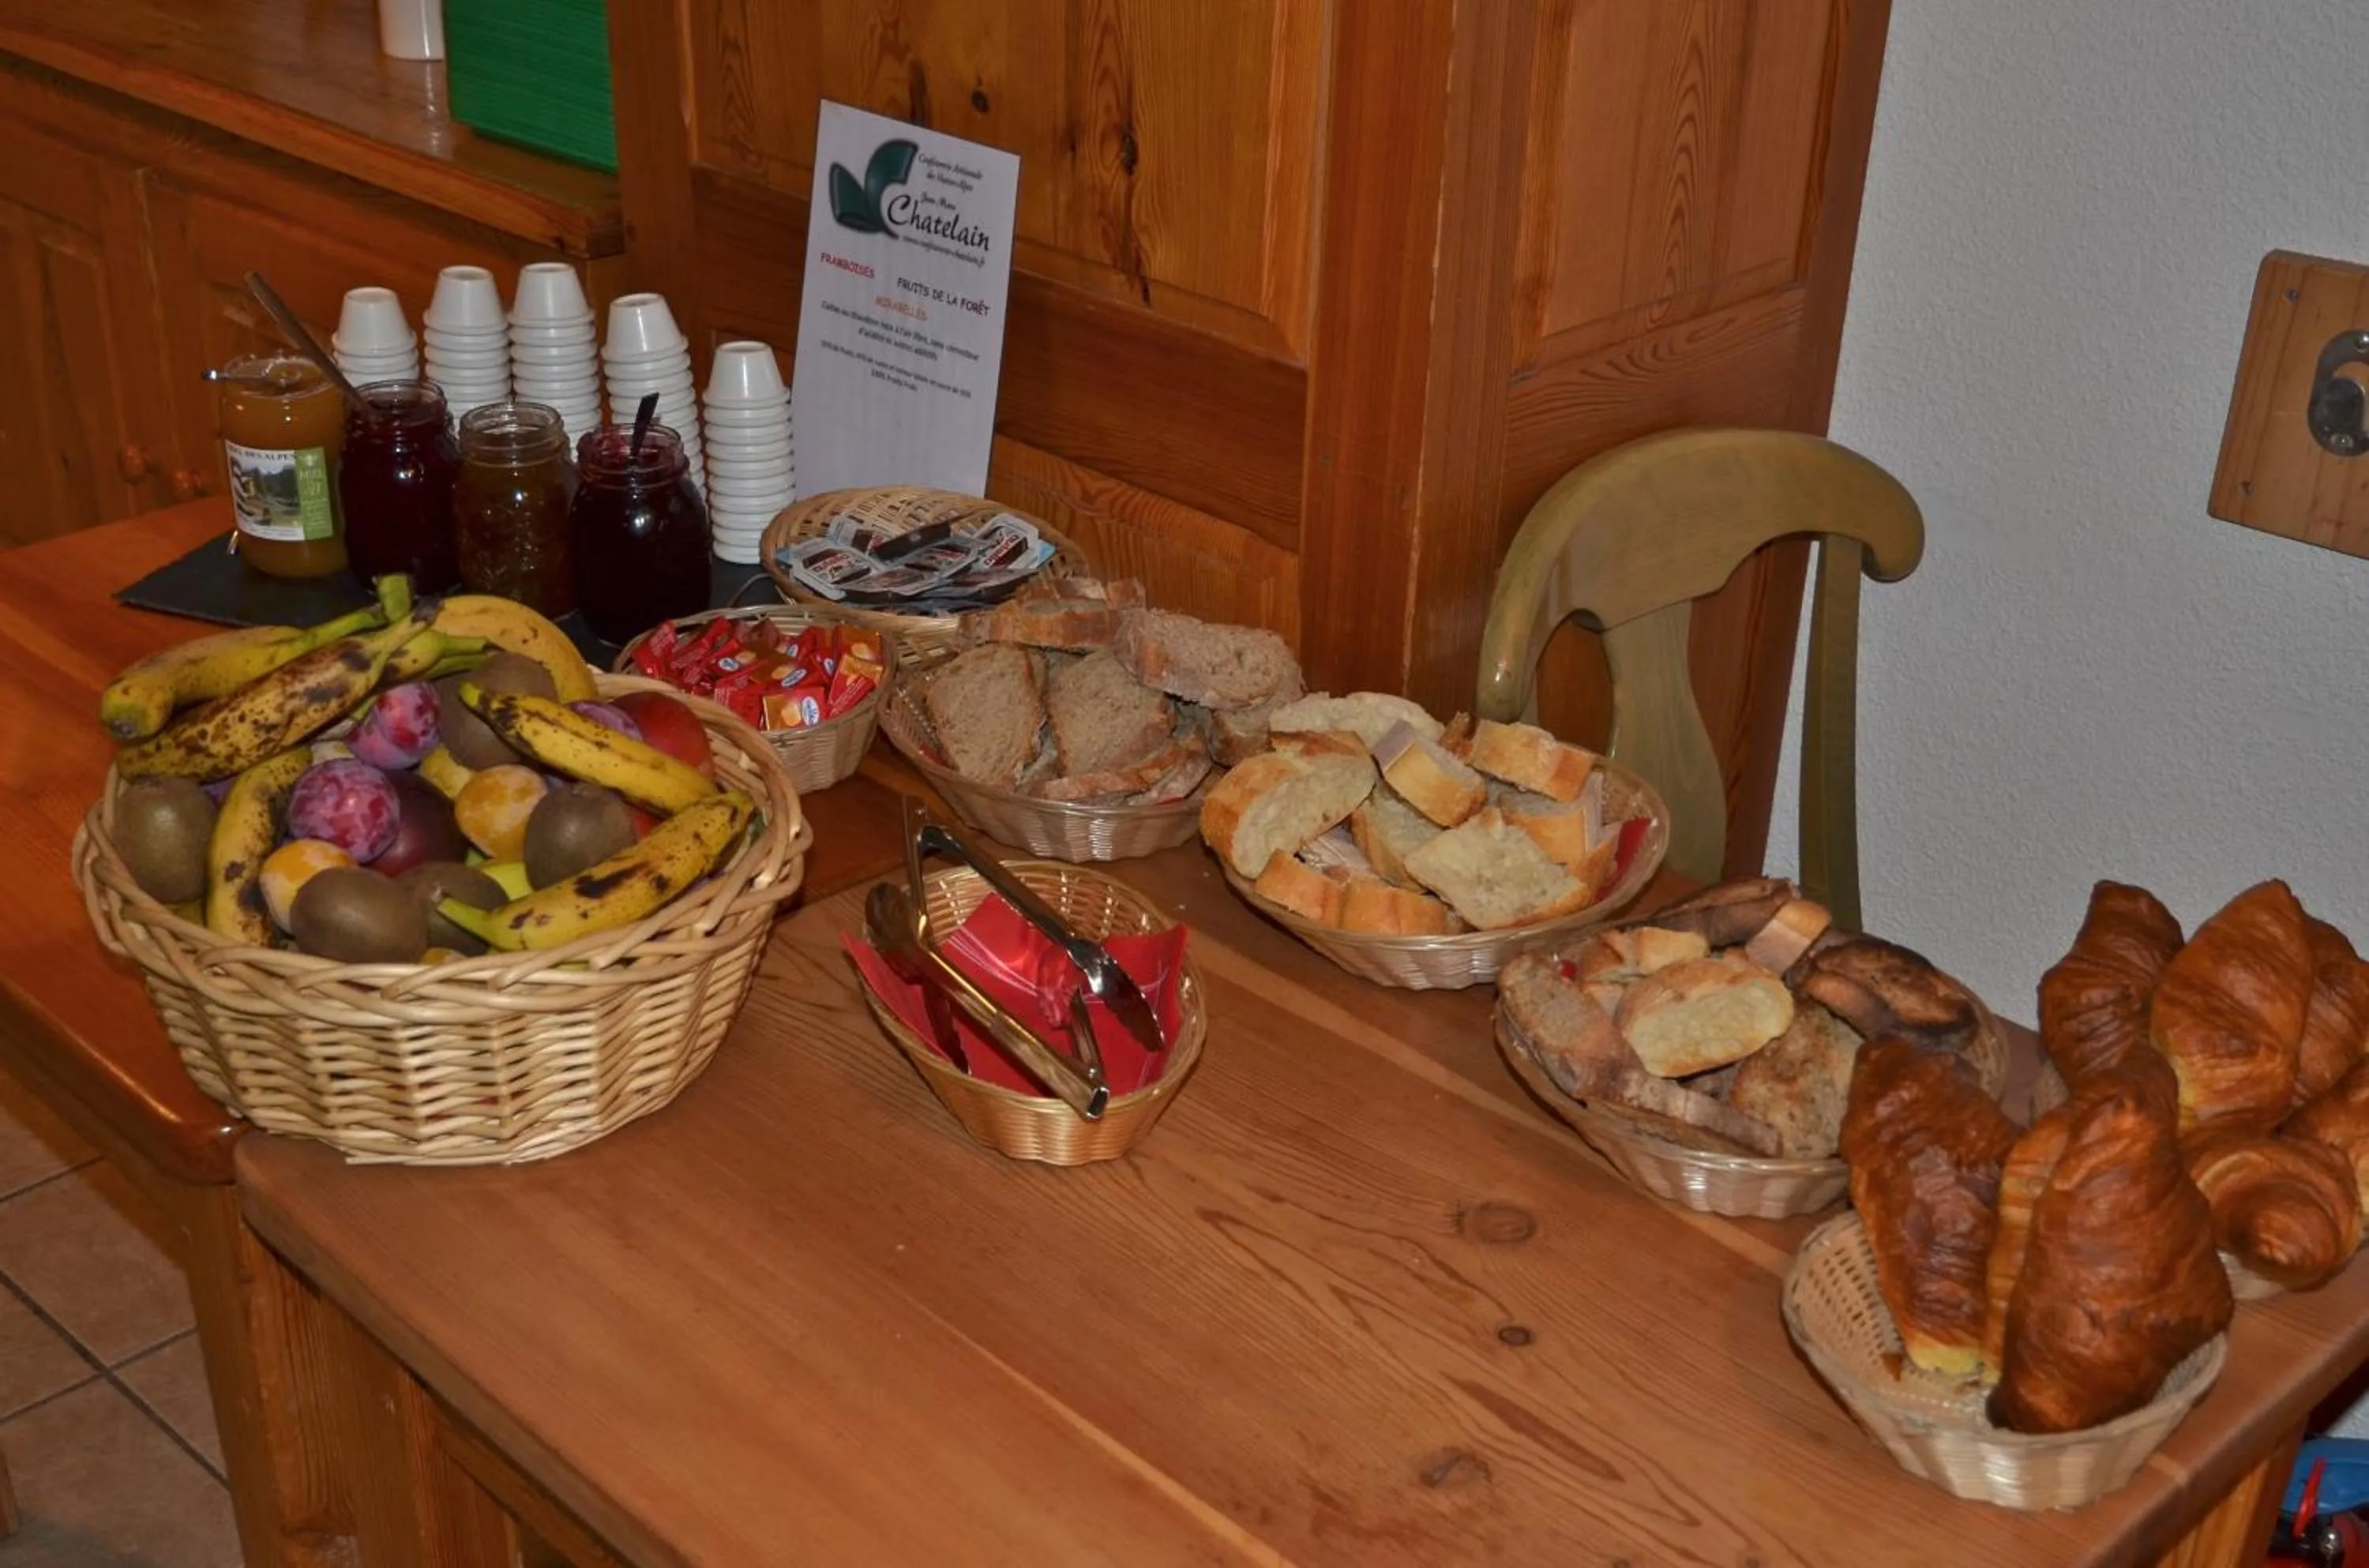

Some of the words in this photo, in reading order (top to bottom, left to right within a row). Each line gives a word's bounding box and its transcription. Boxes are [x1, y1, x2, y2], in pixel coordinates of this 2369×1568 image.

[888, 194, 990, 251] Chatelain
[820, 252, 875, 279] FRAMBOISES
[896, 277, 929, 298] FRUITS
[933, 287, 945, 302] DE
[947, 292, 958, 307] LA
[959, 295, 990, 316] FORÊT
